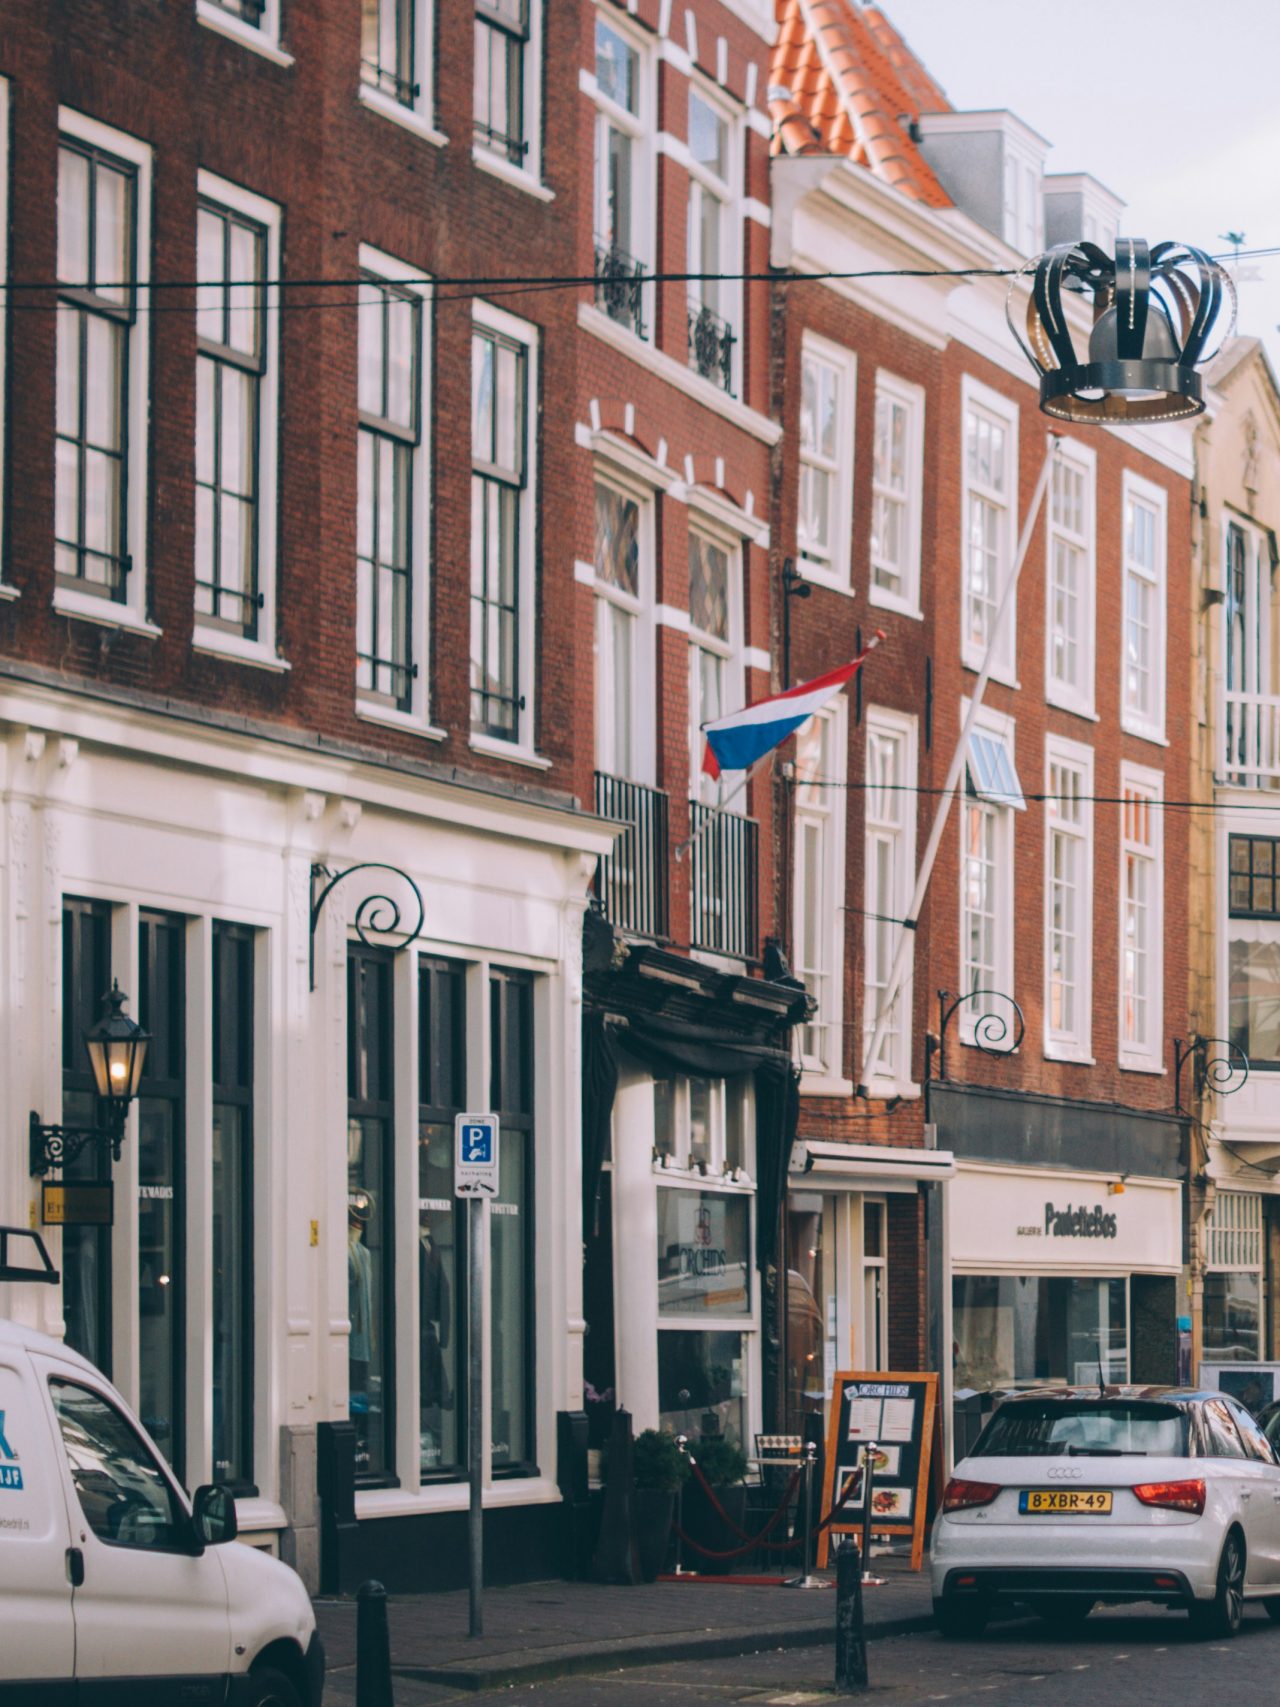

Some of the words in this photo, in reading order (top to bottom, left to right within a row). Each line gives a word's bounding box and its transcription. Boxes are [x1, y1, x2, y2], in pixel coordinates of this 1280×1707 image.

[469, 1127, 484, 1148] P
[679, 1247, 727, 1277] ORCHIDS
[1032, 1493, 1106, 1509] 8-XBR-49
